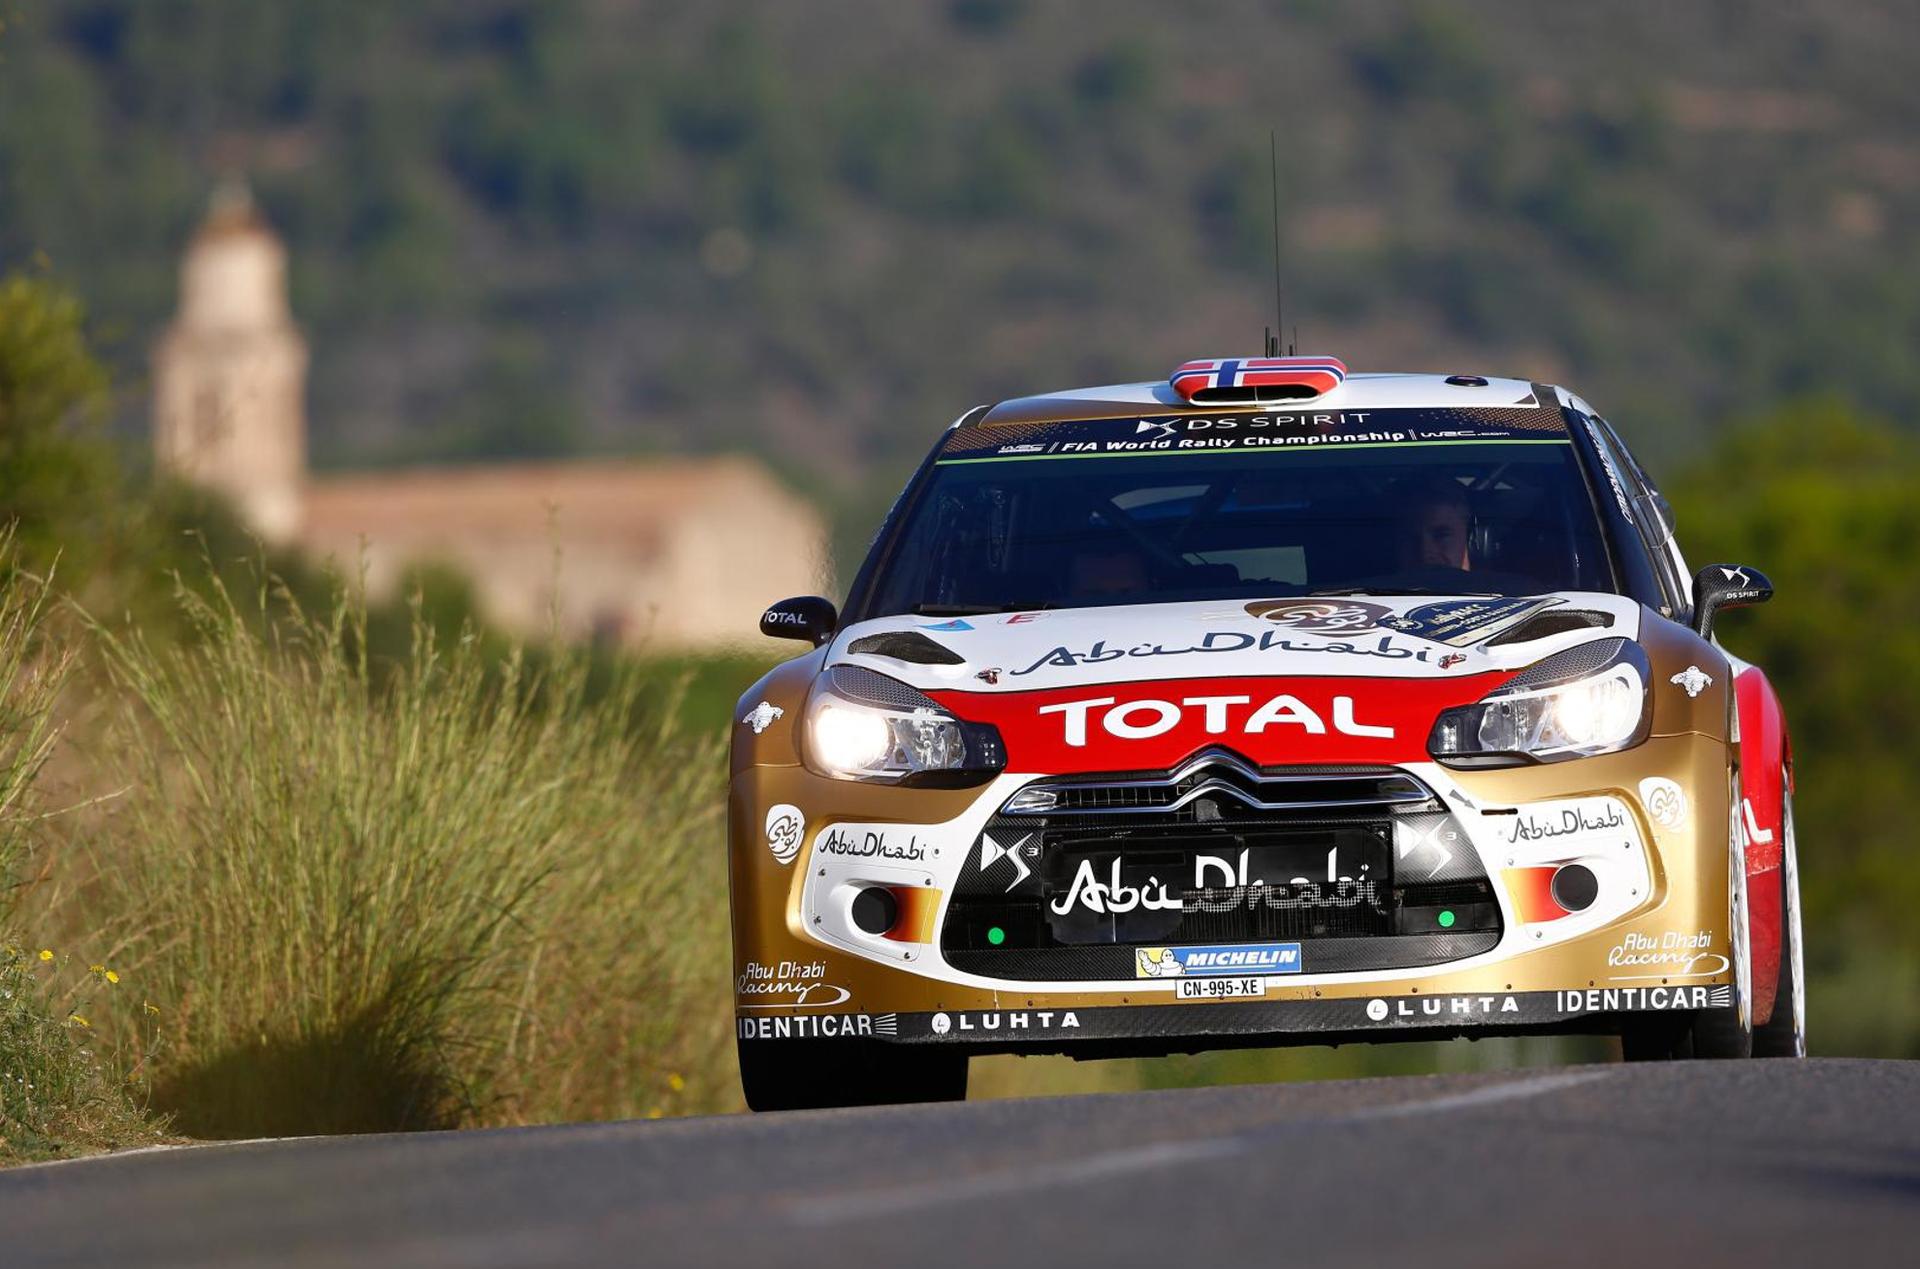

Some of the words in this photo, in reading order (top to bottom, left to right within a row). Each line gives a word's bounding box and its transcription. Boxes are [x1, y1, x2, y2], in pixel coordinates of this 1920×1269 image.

[1187, 419, 1238, 430] DS
[1250, 413, 1370, 428] SPIRIT
[1061, 441, 1098, 452] FIA
[1106, 440, 1172, 451] World
[1178, 438, 1235, 448] Rally
[1243, 431, 1405, 446] Championship
[1739, 590, 1760, 598] SPIRIT
[764, 610, 806, 624] TOTAL
[1039, 694, 1395, 747] TOTAL
[1624, 933, 1658, 950] Abu
[1663, 930, 1713, 949] Dhabi
[1186, 950, 1297, 966] MICHELIN
[1608, 946, 1708, 974] Racing
[746, 962, 773, 979] Abu
[778, 961, 826, 979] Dhabi
[1183, 979, 1259, 996] CN-995-XE
[1398, 996, 1519, 1016] LUHTA
[1557, 987, 1708, 1013] IDENTICAR
[738, 1014, 872, 1040] IDENTICAR
[960, 1011, 1080, 1030] LUHTA
